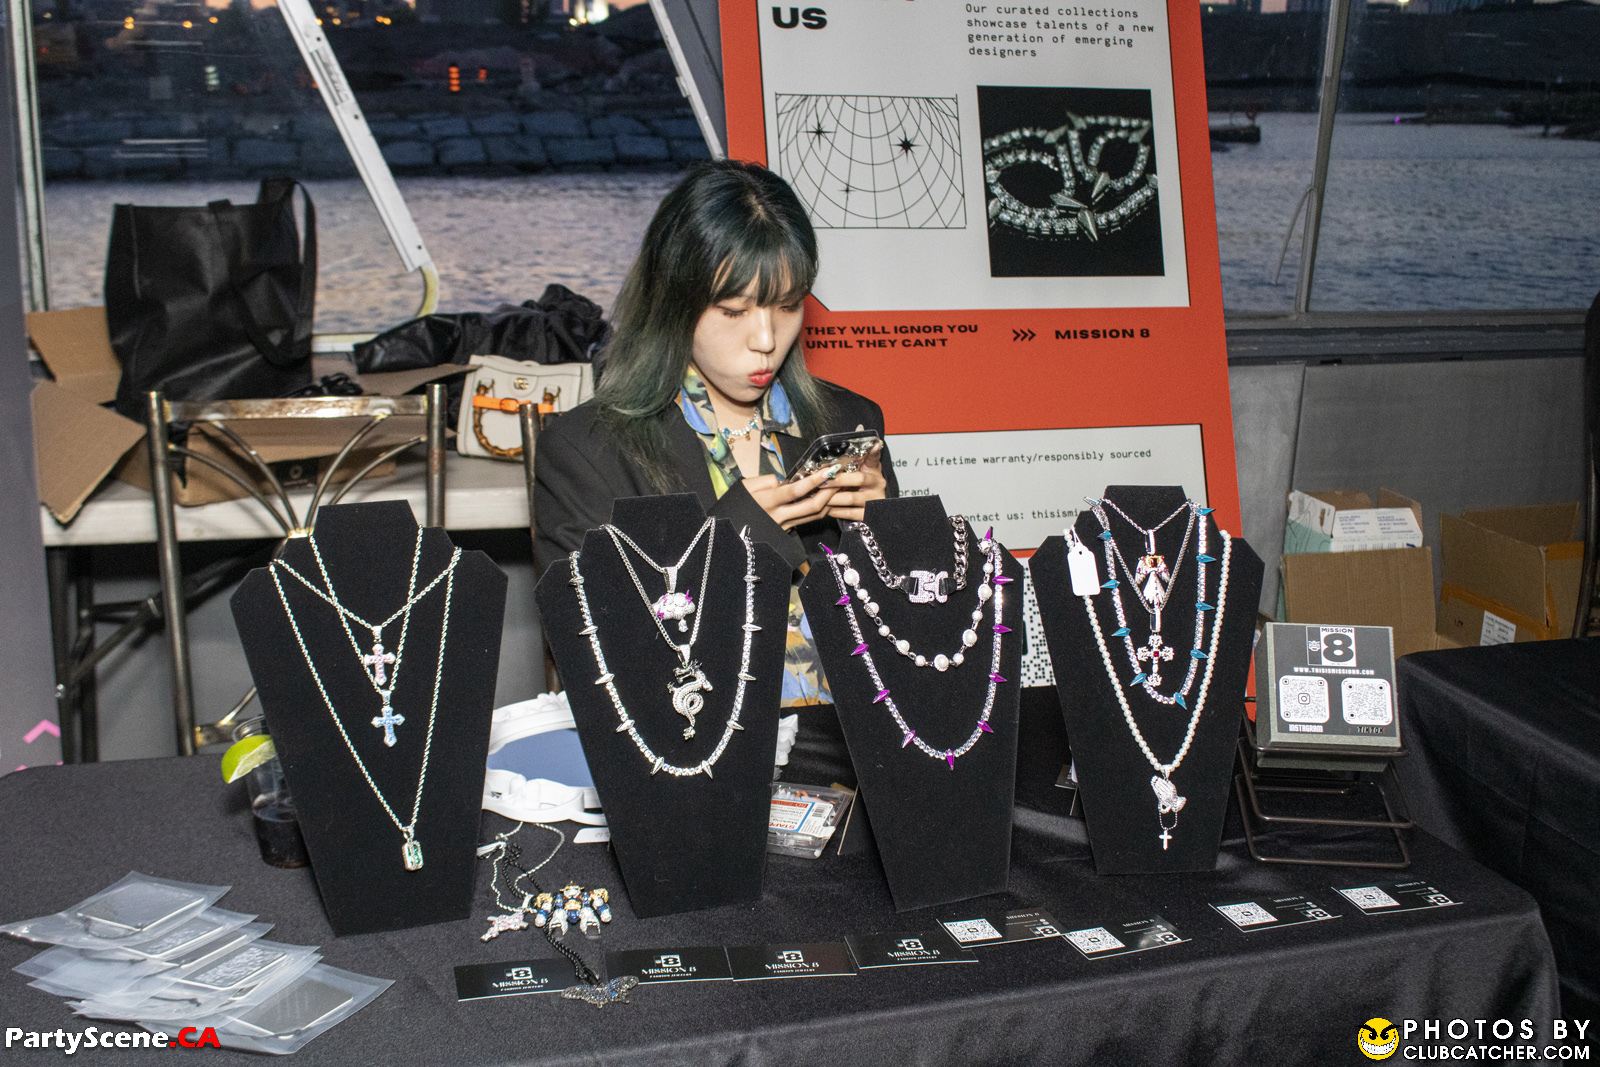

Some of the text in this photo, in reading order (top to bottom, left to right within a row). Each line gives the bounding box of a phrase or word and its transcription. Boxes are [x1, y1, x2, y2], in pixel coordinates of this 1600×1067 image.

[772, 6, 828, 29] US
[966, 4, 1139, 18] Our curated collections
[966, 18, 1027, 29] showcase
[1036, 20, 1088, 30] talents
[1096, 22, 1108, 31] of
[1132, 24, 1154, 32] new
[967, 33, 1133, 48] generation of emerging
[968, 47, 1037, 58] designers
[806, 324, 978, 335] THEY WILL IGNOR YOU
[1055, 328, 1150, 340] MISSION 8
[806, 339, 853, 349] UNTIL
[857, 339, 898, 348] THEY
[926, 456, 977, 467] Lifetime
[982, 450, 1104, 465] warranty/responsibly
[1110, 449, 1152, 460] sourced
[963, 512, 1000, 522] ontact
[1031, 508, 1079, 520] thisismi
[1323, 633, 1354, 663] 8
